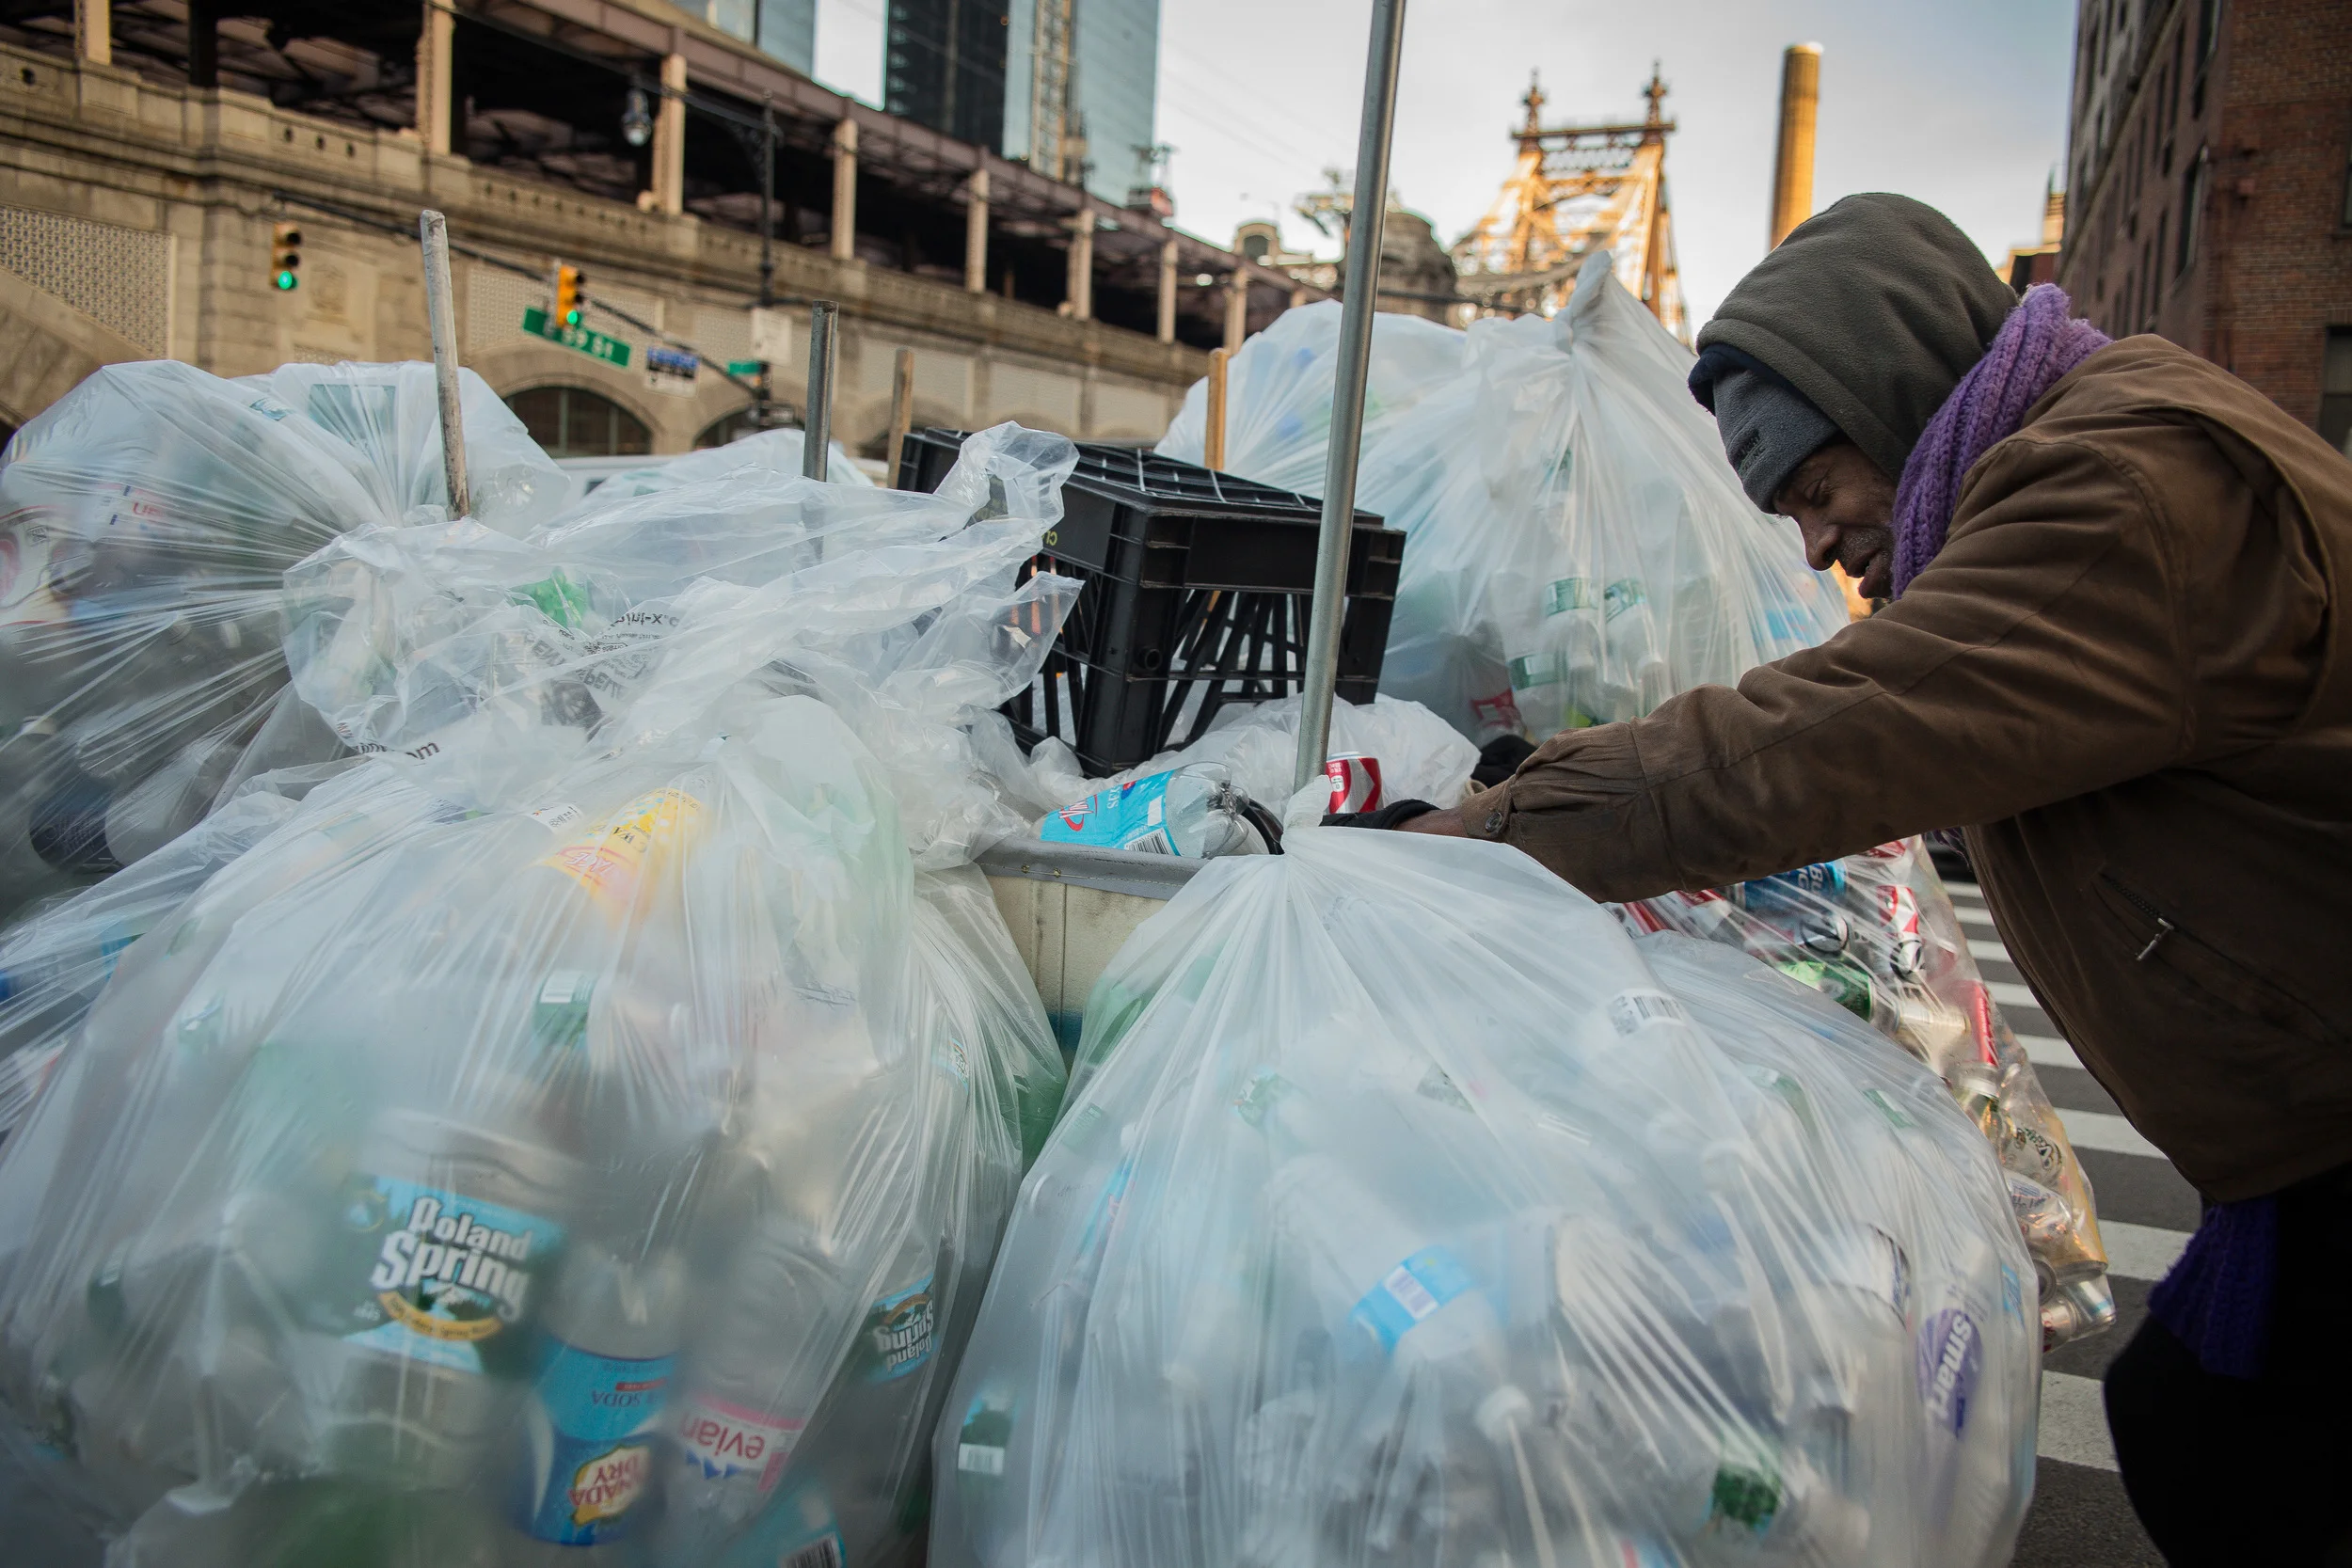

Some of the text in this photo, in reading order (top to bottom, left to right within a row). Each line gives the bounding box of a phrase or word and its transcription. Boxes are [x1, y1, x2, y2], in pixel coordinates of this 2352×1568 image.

[407, 1196, 533, 1261] Poland
[372, 1229, 531, 1323] Spring
[872, 1299, 934, 1353] Spring
[885, 1333, 932, 1372] Poland
[591, 1389, 642, 1409] SODA
[676, 1411, 766, 1462] evian
[594, 1454, 639, 1486] DRY
